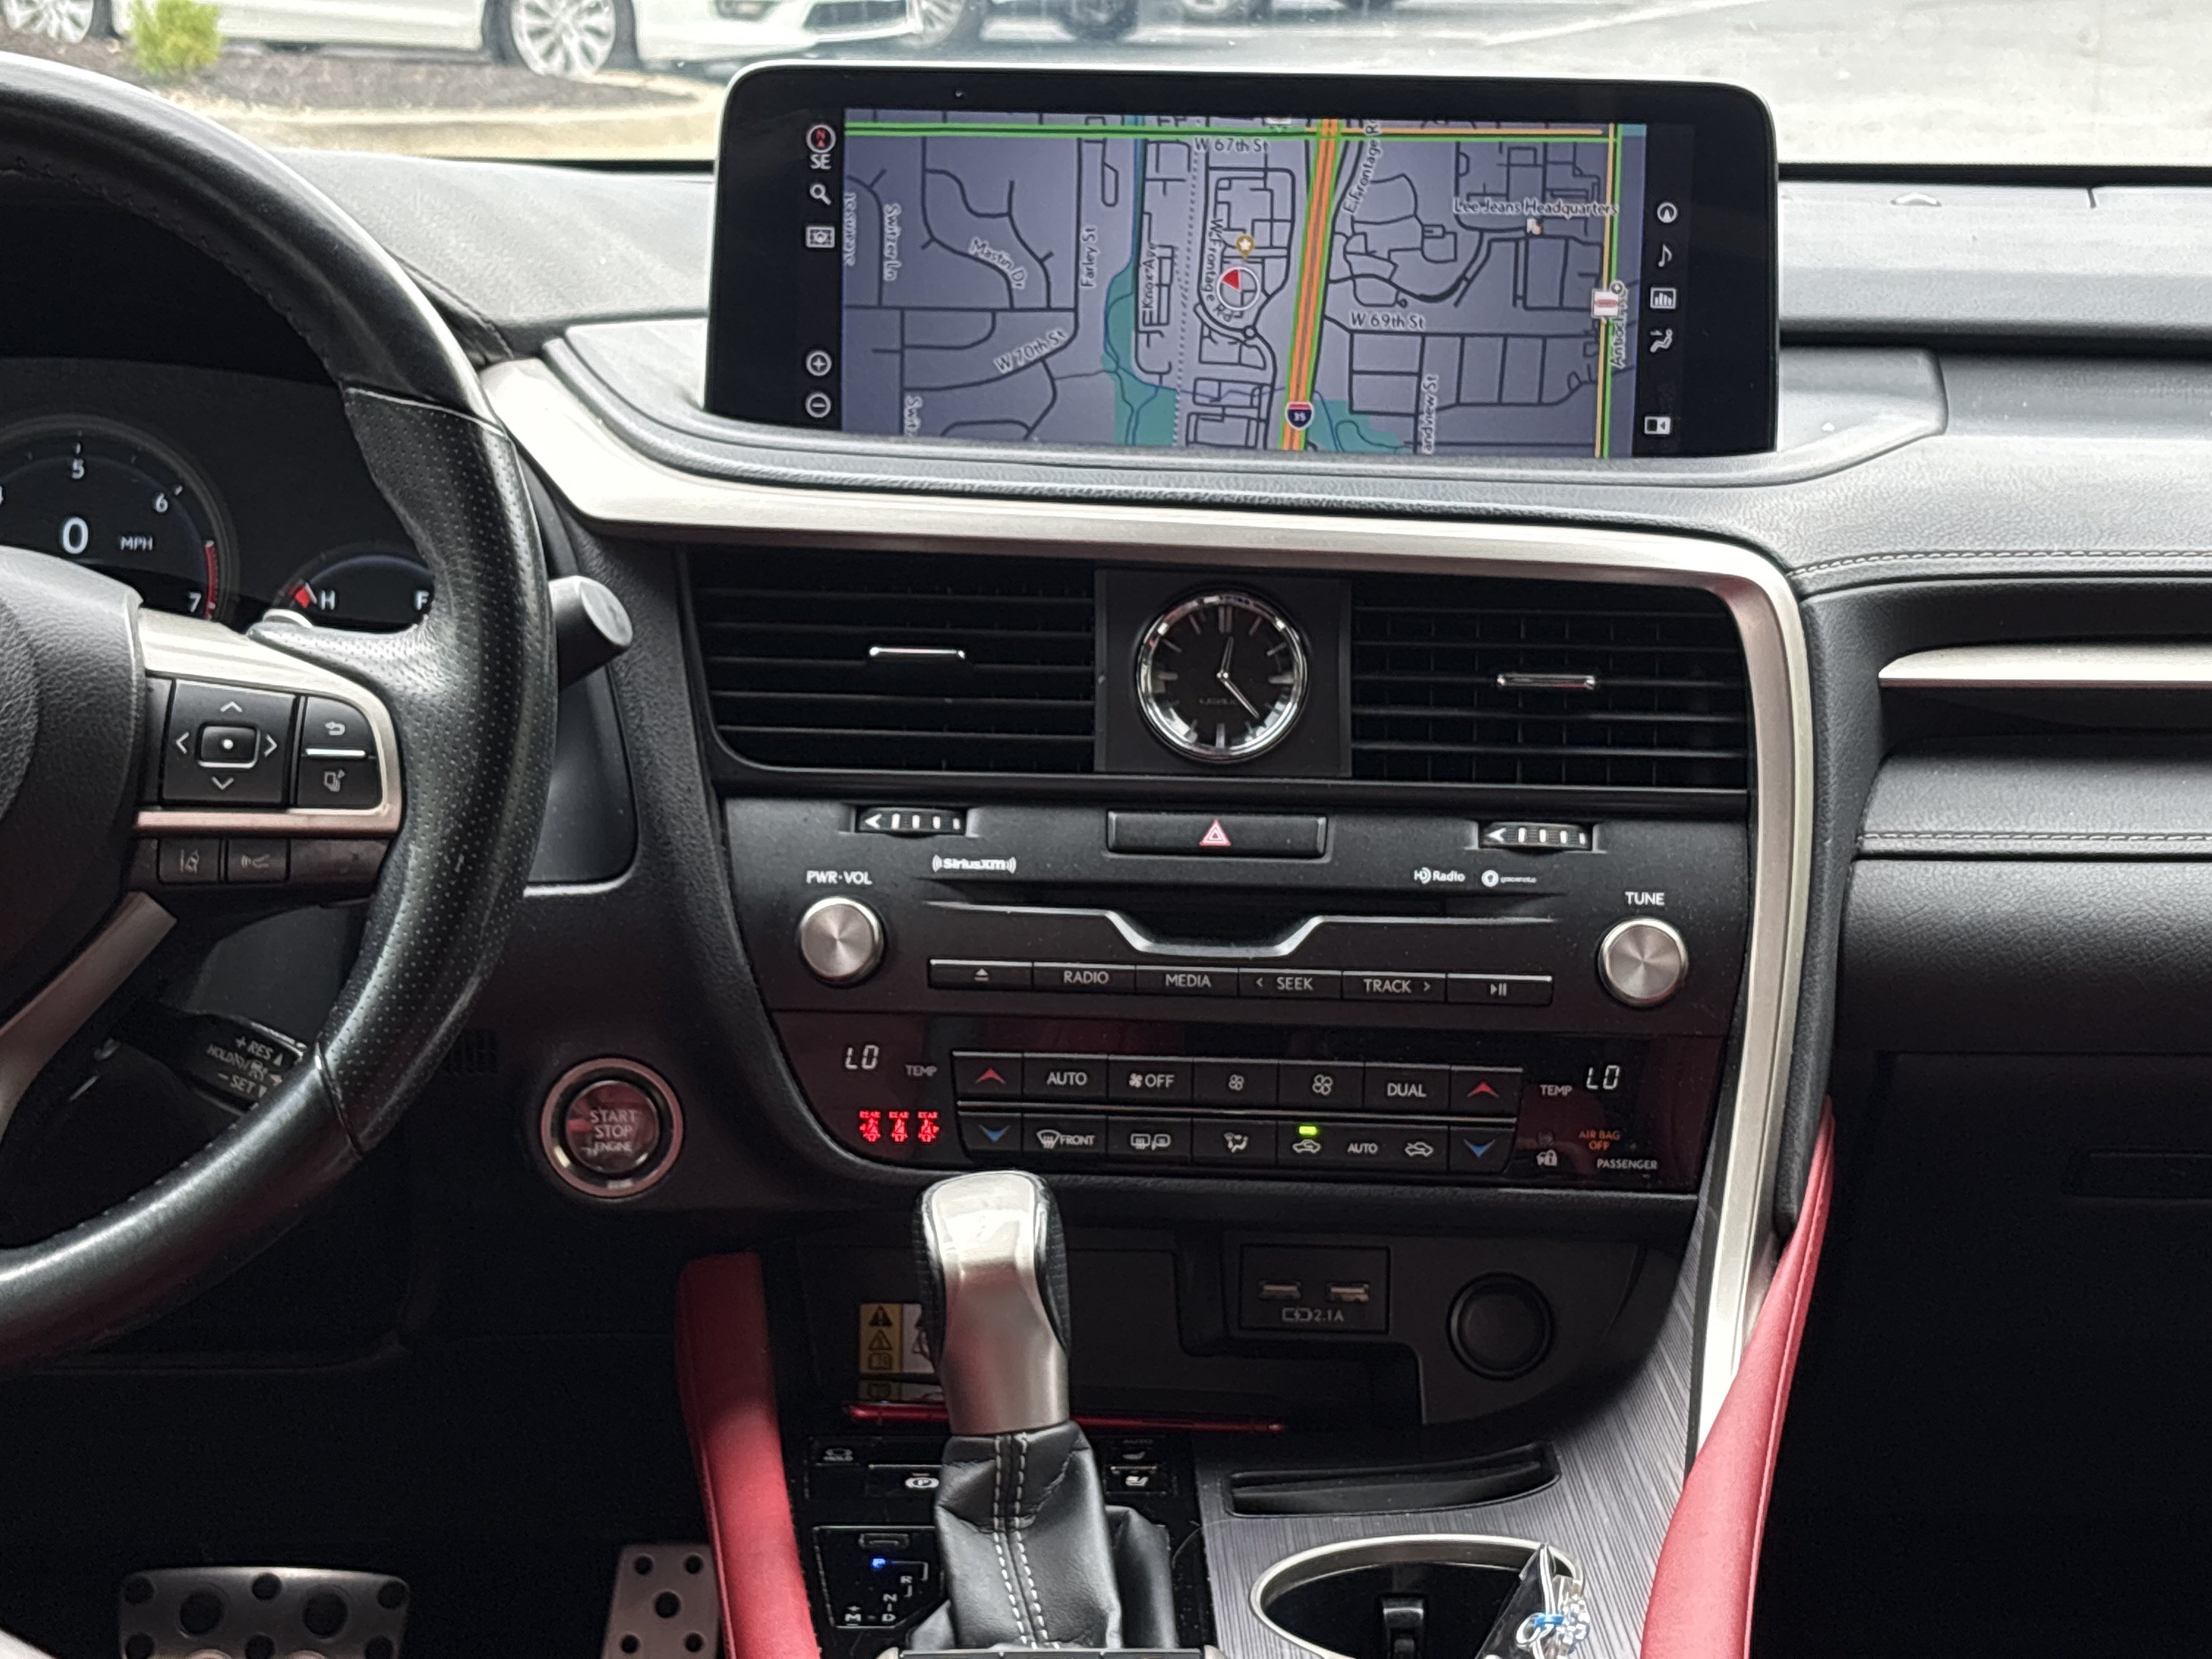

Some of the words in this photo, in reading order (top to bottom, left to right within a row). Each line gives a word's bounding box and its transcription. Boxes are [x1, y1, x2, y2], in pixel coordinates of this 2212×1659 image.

[1194, 137, 1207, 151] W
[1215, 138, 1249, 153] 67th
[1253, 138, 1268, 152] St
[809, 153, 832, 170] SE
[1349, 139, 1382, 200] Frontage
[1454, 198, 1479, 213] Lee
[1483, 198, 1520, 213] Jeans
[1524, 198, 1619, 218] Headquarters
[1082, 227, 1096, 241] St
[1141, 242, 1158, 267] Ave
[972, 238, 1012, 270] Mastin
[1012, 270, 1025, 288] Dr
[1081, 248, 1097, 288] Farley
[1201, 236, 1222, 302] Frontage
[1214, 304, 1233, 323] Rd
[1141, 271, 1156, 308] Knox
[1351, 312, 1367, 326] W
[1370, 313, 1406, 329] 69th
[1408, 314, 1424, 329] St
[994, 357, 1011, 373] W
[1015, 340, 1047, 365] 70th
[1048, 330, 1066, 347] St
[1423, 375, 1436, 392] St
[1293, 411, 1307, 422] 35
[71, 459, 85, 479] 5
[155, 493, 168, 514] 6
[62, 516, 89, 555] 0
[120, 535, 154, 551] MPH
[189, 591, 202, 613] 7
[321, 589, 336, 611] H
[415, 590, 430, 611] F
[1432, 870, 1466, 883] Radio
[1624, 891, 1665, 906] TUNE
[1063, 970, 1110, 985] RADIO
[1165, 973, 1212, 988] MEDIA
[1276, 977, 1314, 991] SEEK
[1363, 978, 1412, 994] TRACK
[247, 1040, 274, 1061] RES
[844, 1044, 880, 1070] LO
[905, 1064, 938, 1077] TEMP
[1585, 1064, 1621, 1090] LO
[229, 1074, 257, 1094] SET
[1046, 1071, 1088, 1087] AUTO
[1144, 1073, 1176, 1089] OFF
[1386, 1082, 1427, 1098] DUAL
[1539, 1084, 1573, 1097] TEMP
[589, 1109, 638, 1124] START
[594, 1125, 634, 1139] STOP
[1578, 1129, 1597, 1139] AIR
[1599, 1130, 1621, 1141] BAG
[594, 1141, 634, 1152] ENGINE
[1059, 1134, 1096, 1147] FRONT
[1347, 1142, 1379, 1154] AUTO
[1588, 1141, 1611, 1151] OFF
[1596, 1158, 1658, 1171] PASSENGER
[1314, 1308, 1345, 1322] 2.1A
[872, 1558, 886, 1568] P
[900, 1575, 913, 1584] R
[882, 1593, 898, 1602] N
[844, 1613, 862, 1622] M
[881, 1613, 897, 1622] D
